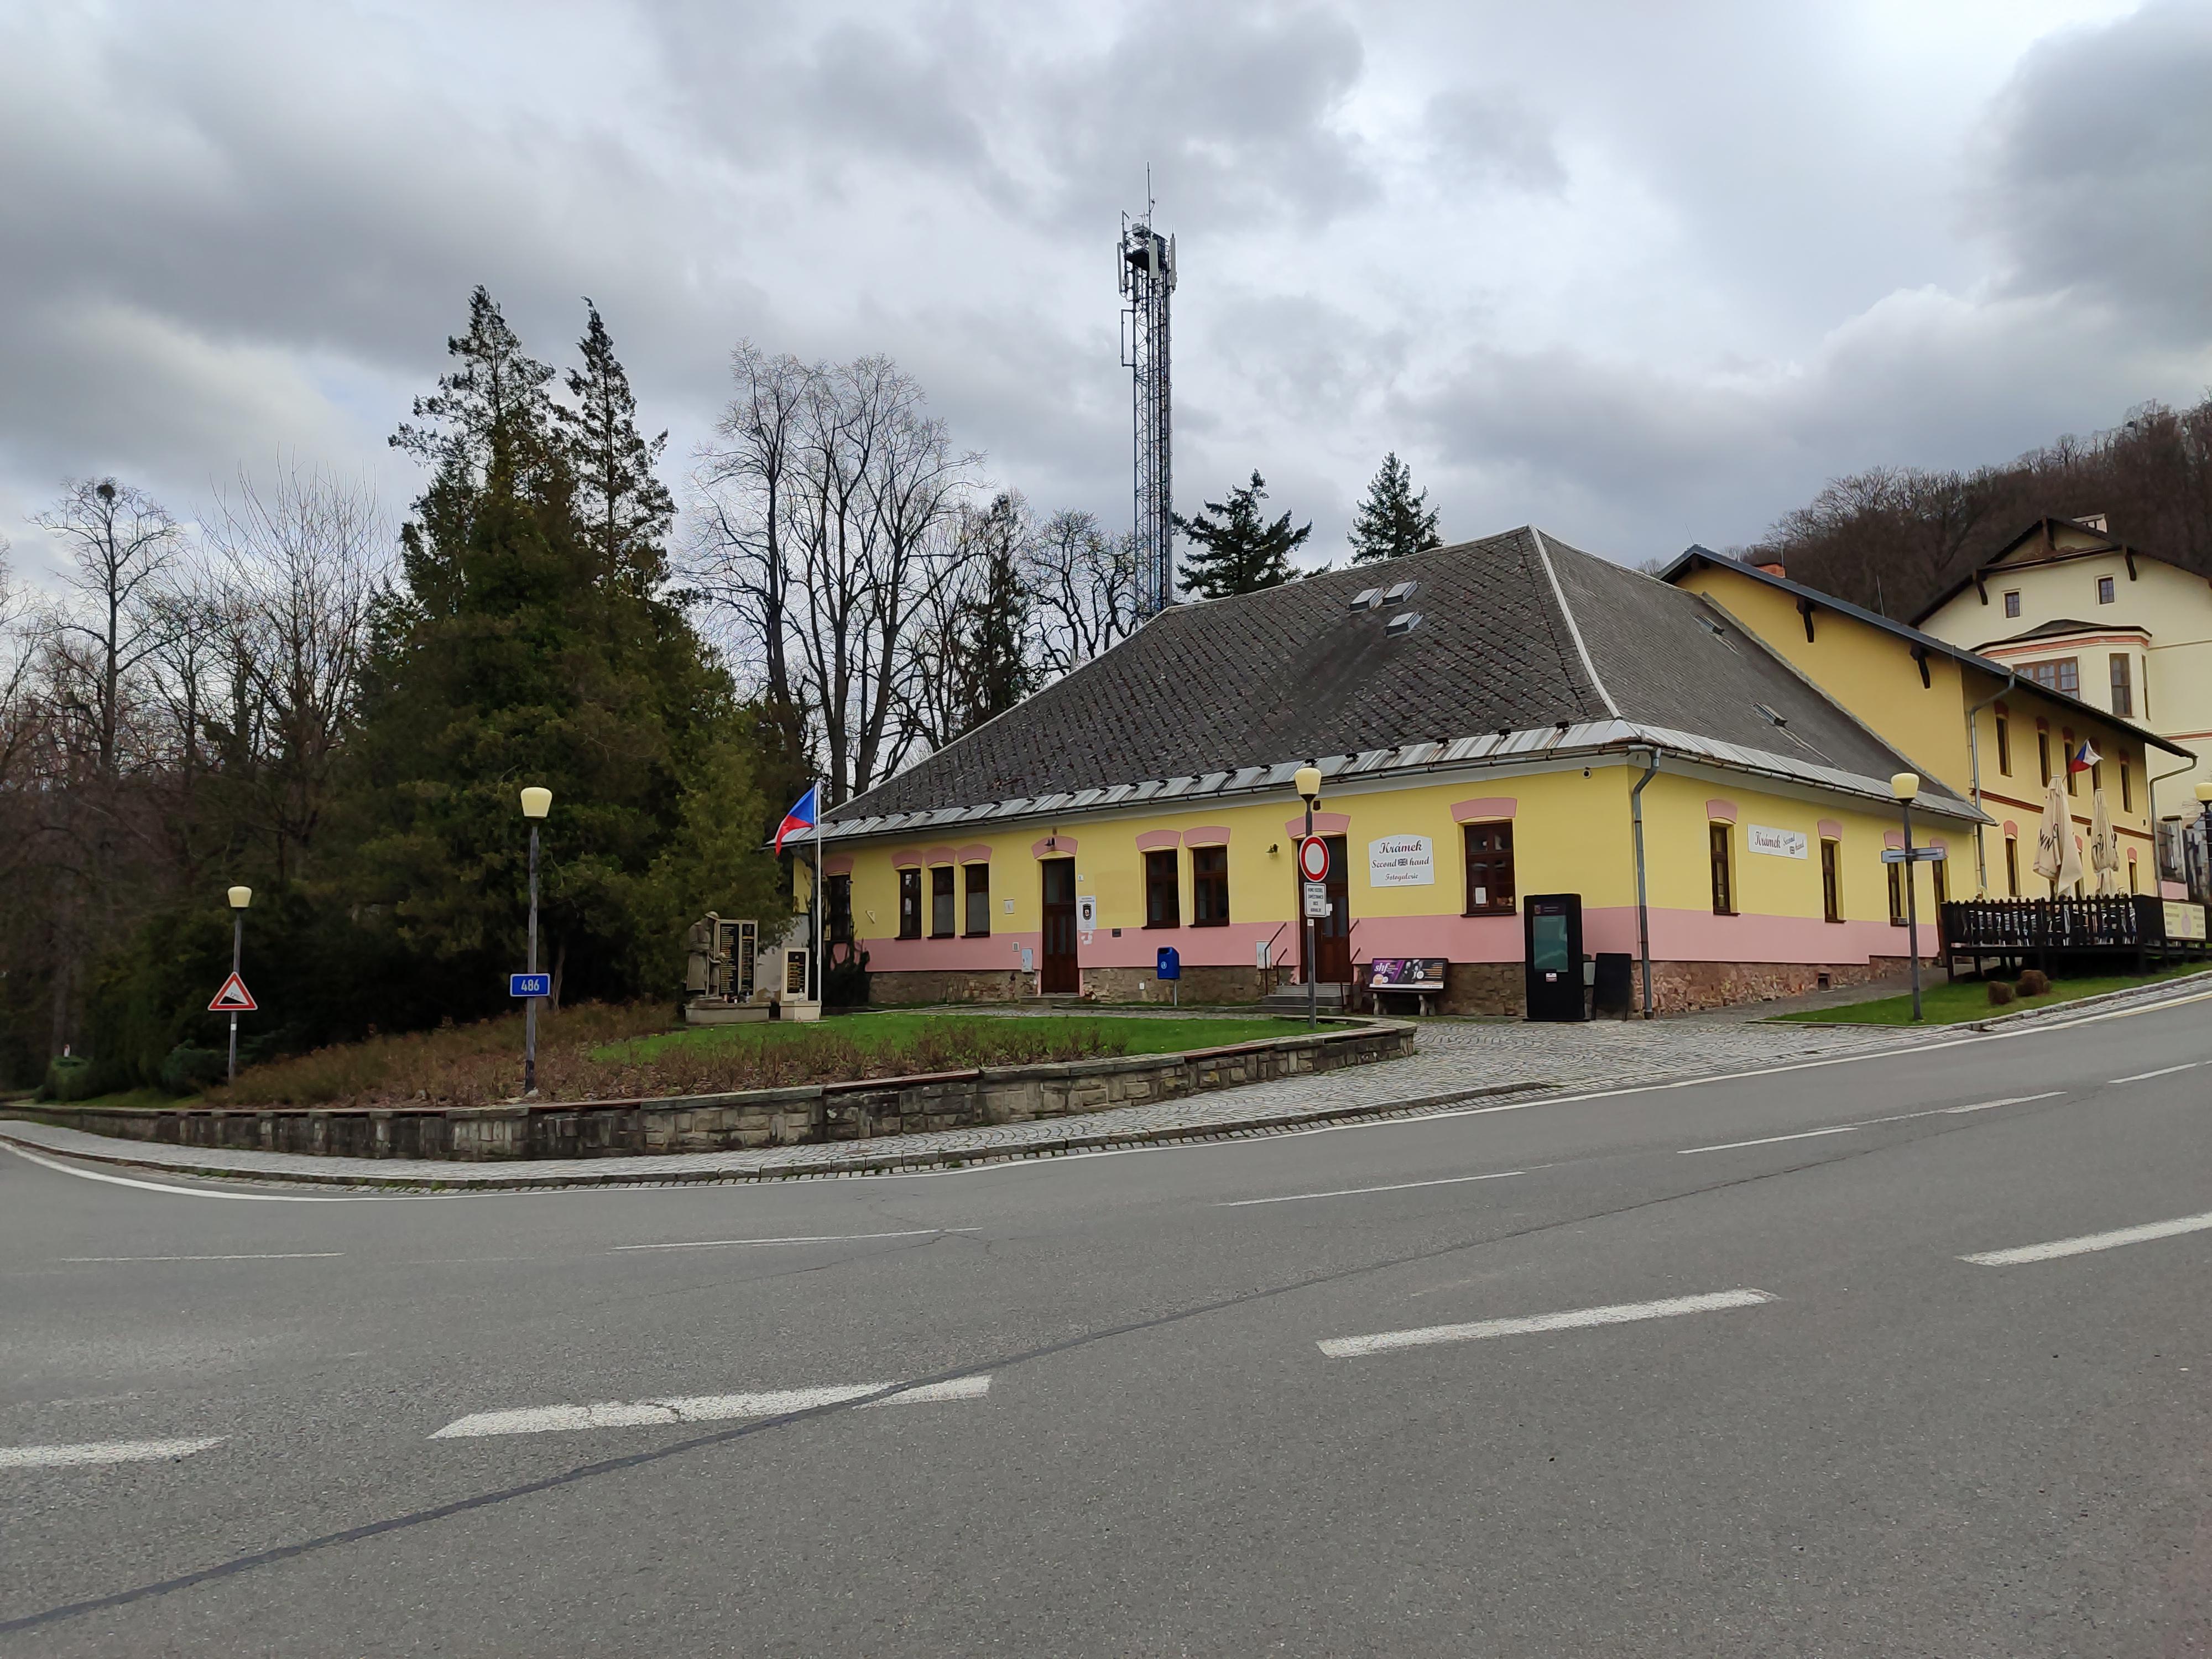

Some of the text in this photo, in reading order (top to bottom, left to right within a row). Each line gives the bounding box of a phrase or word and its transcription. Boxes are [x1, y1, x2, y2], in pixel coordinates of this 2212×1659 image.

[1755, 831, 1781, 848] Krámek
[1379, 840, 1422, 854] Krámek
[1372, 856, 1430, 868] Second hand
[1385, 873, 1418, 882] Fotogalerie
[1374, 962, 1390, 974] shf
[521, 979, 540, 992] 486
